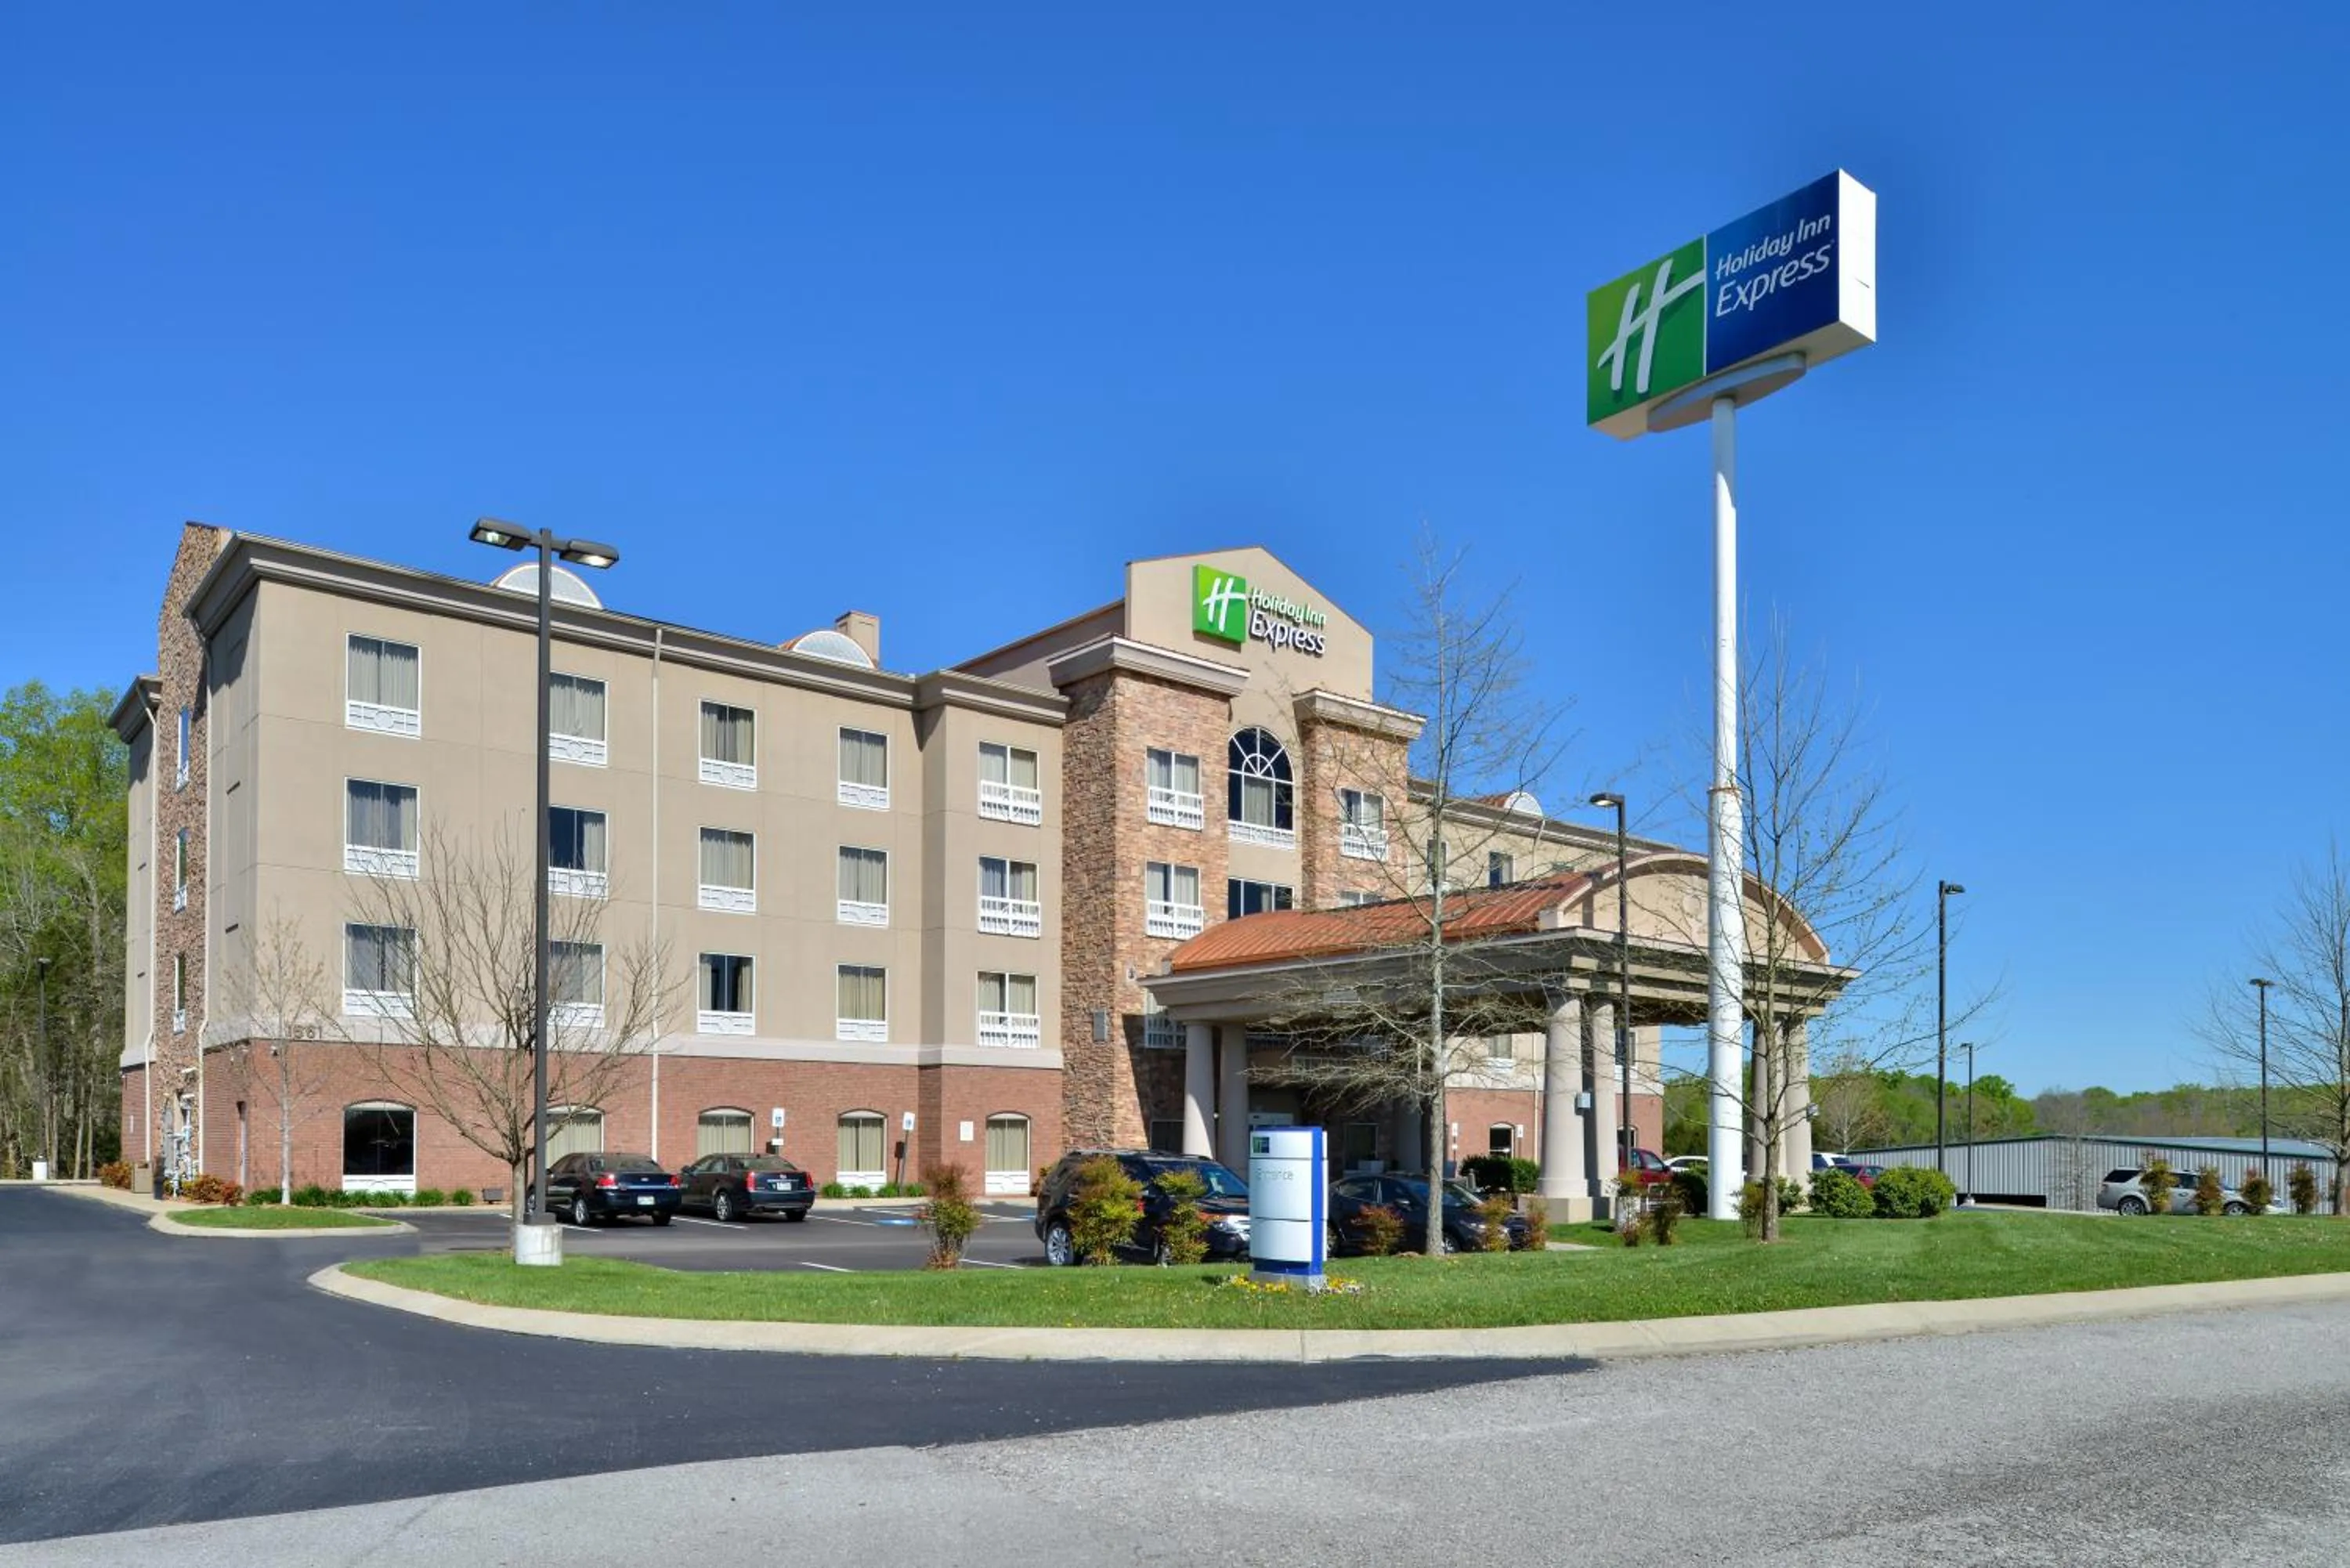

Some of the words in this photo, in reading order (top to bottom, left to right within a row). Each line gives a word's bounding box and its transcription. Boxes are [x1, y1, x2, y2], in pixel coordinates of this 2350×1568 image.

[1715, 230, 1795, 280] Holiday
[1797, 214, 1831, 244] Inn
[1716, 244, 1831, 316] Express
[1251, 587, 1304, 623] Holiday
[1306, 602, 1326, 626] Inn
[1251, 609, 1326, 655] Express
